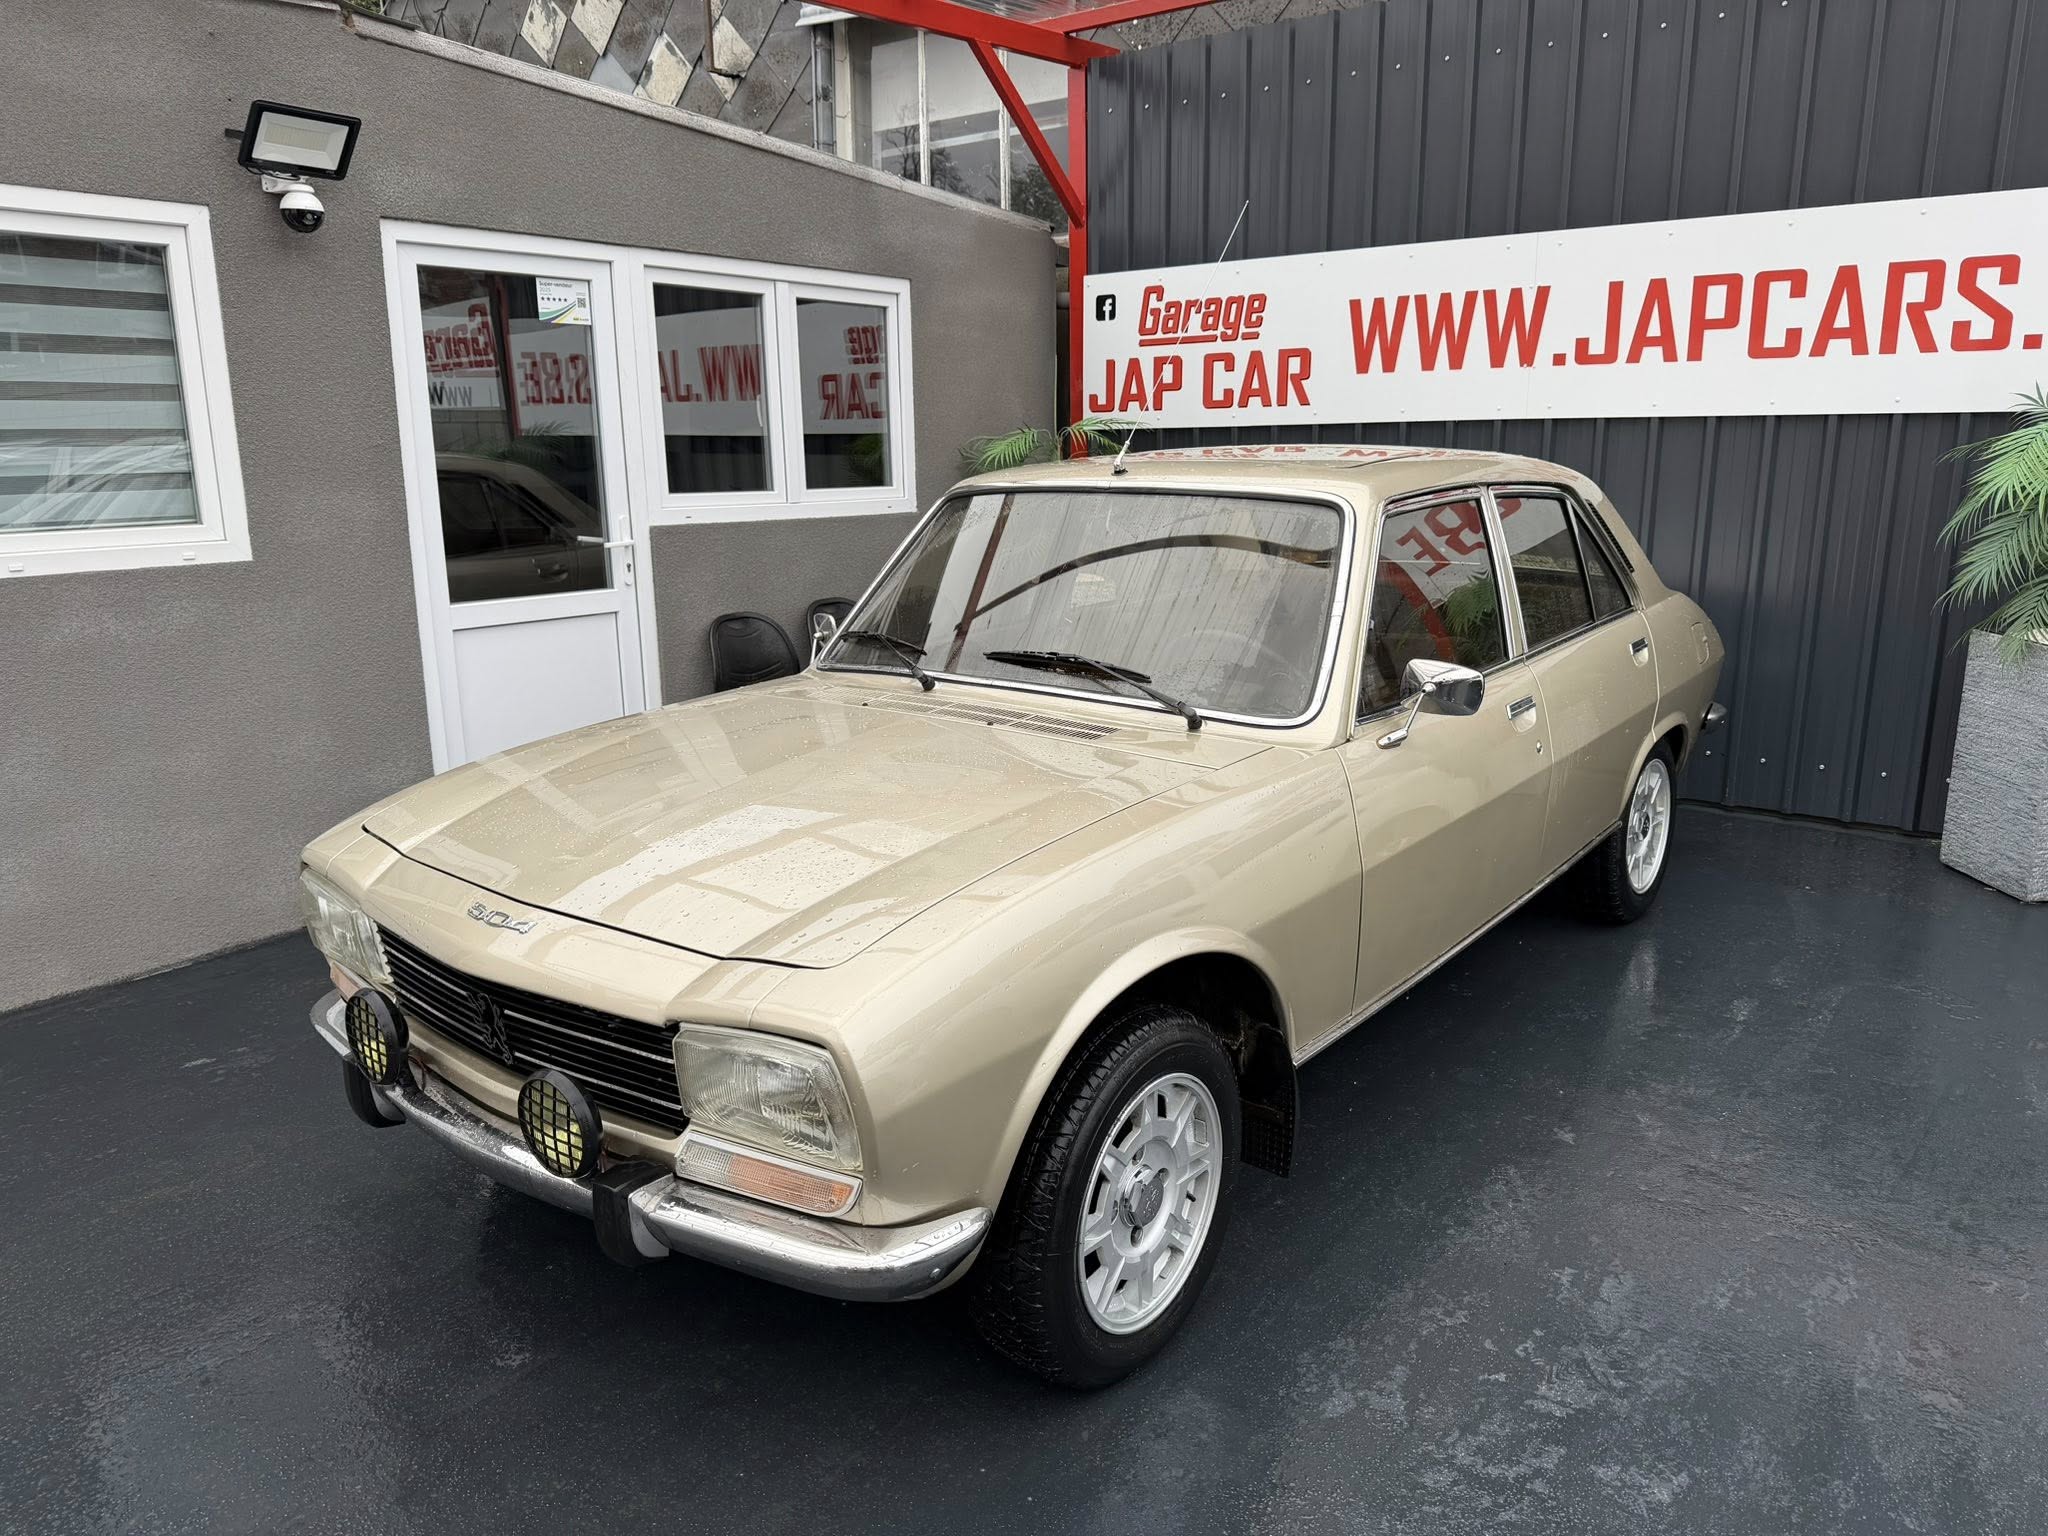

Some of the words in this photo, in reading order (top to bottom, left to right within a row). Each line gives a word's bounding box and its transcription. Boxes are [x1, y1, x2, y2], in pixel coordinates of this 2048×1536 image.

[1138, 285, 1268, 342] Garage
[1348, 253, 2044, 375] WWW.JAPCARS.
[1088, 355, 1183, 413] JAP
[1202, 347, 1312, 410] CAR
[467, 901, 538, 935] 504
